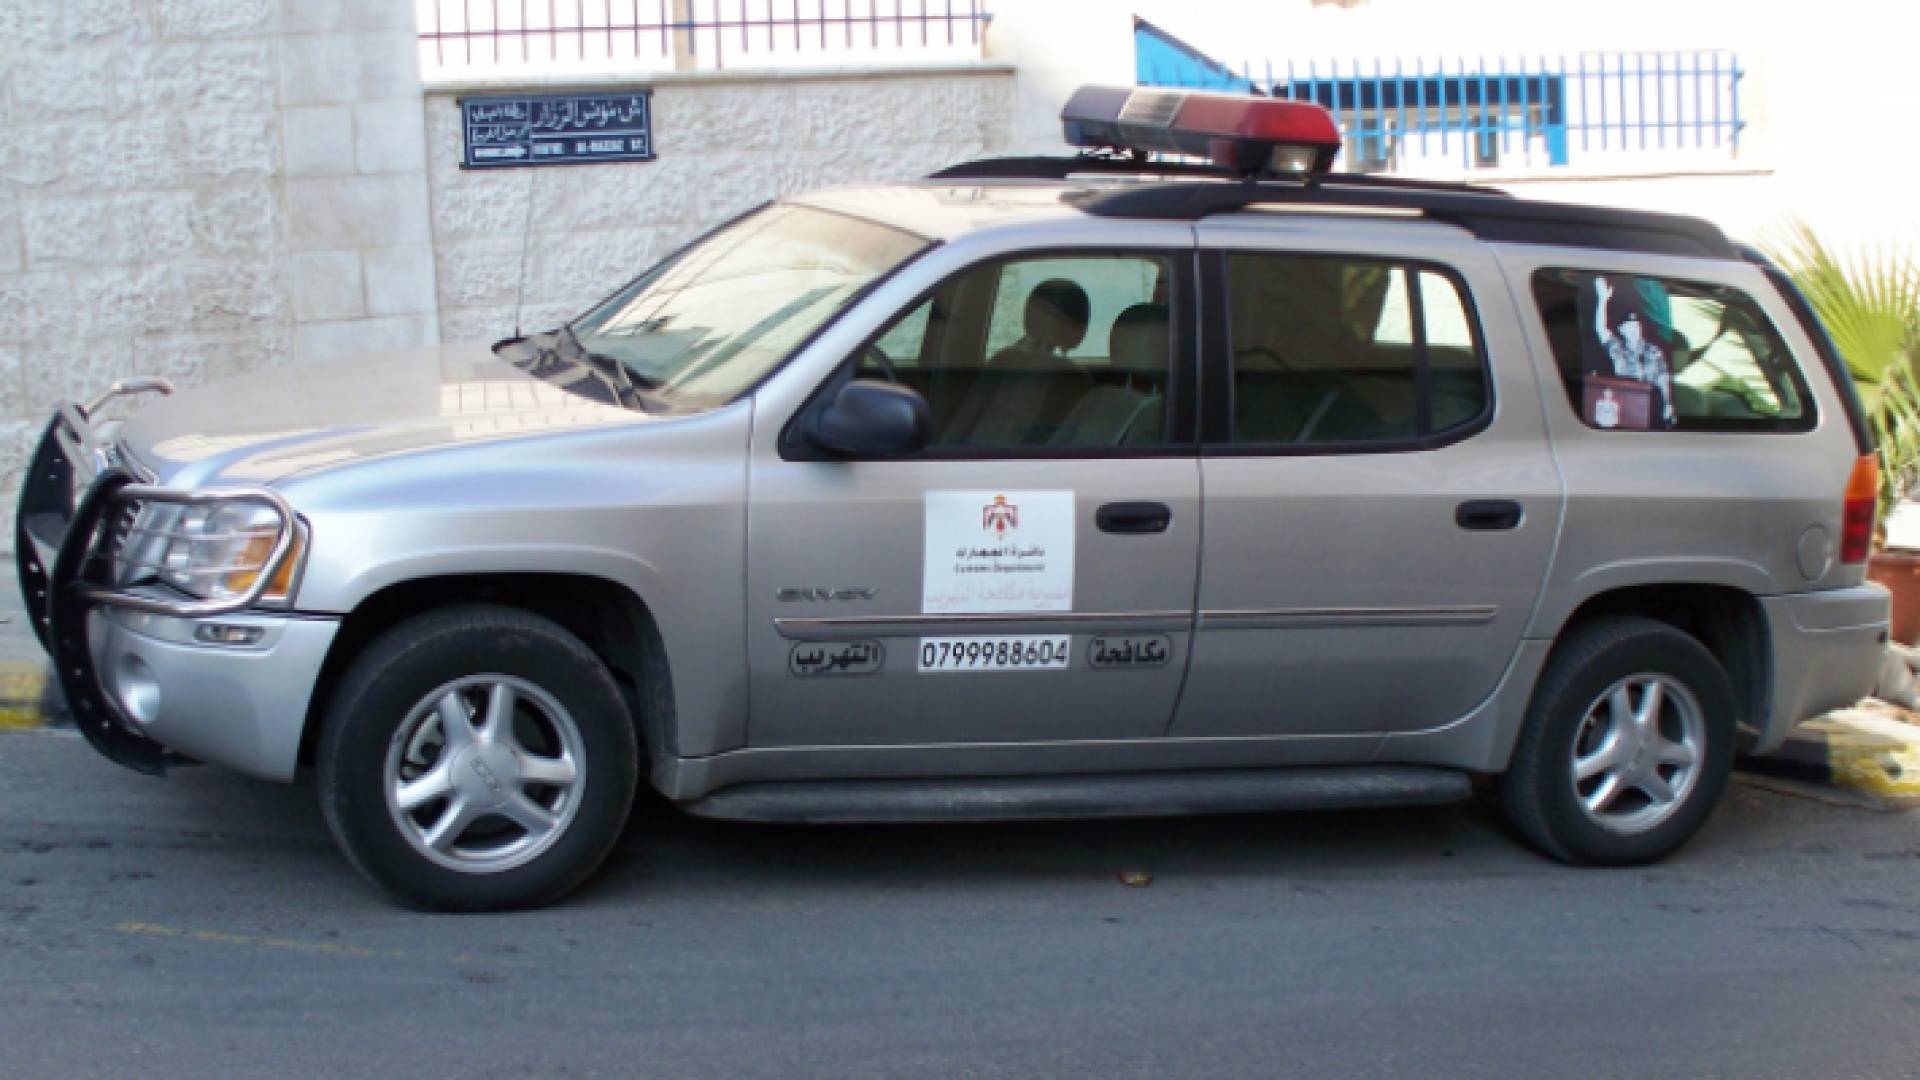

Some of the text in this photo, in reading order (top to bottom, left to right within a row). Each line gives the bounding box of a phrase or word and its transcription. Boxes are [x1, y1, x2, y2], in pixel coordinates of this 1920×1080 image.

[796, 643, 879, 672] التهريب
[922, 639, 1068, 668] 0799988604
[1095, 638, 1166, 663] مكافحة
